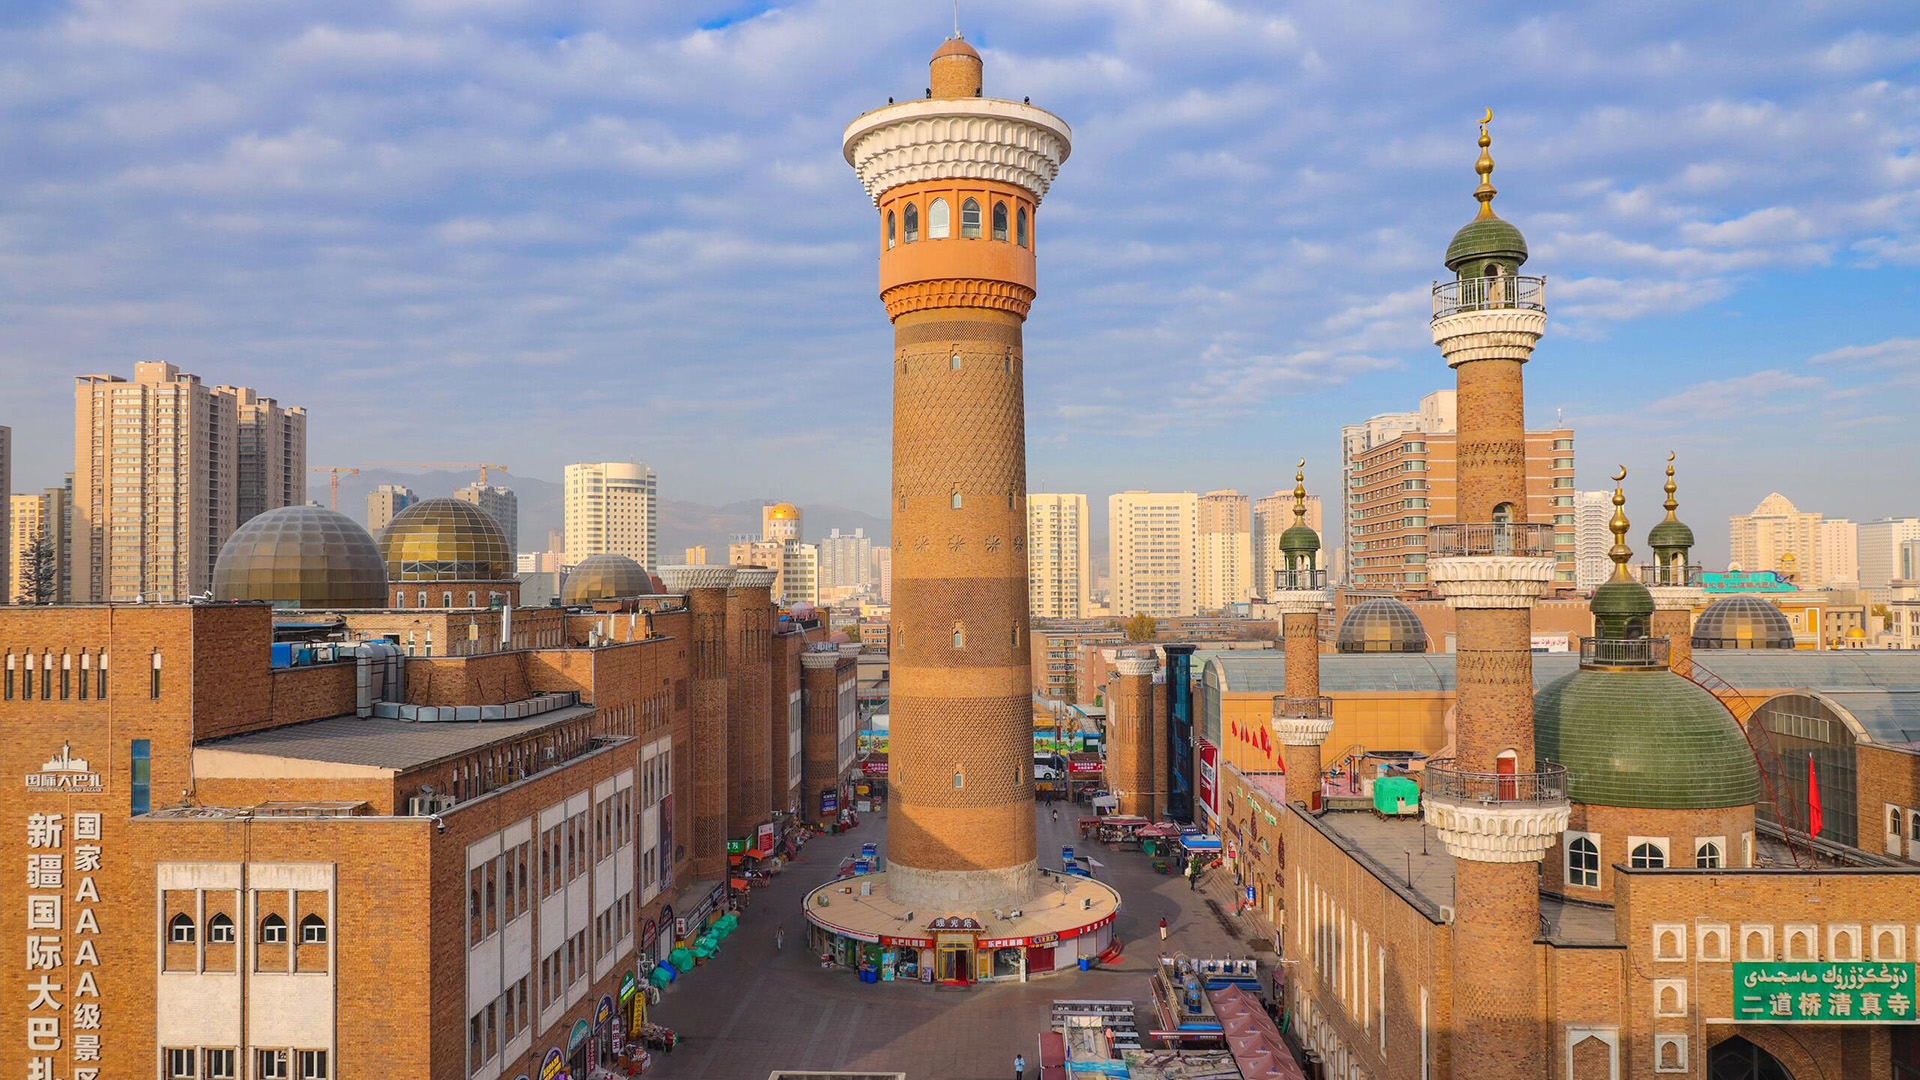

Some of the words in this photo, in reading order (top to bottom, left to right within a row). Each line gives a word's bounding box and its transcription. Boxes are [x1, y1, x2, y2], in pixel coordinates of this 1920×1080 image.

[25, 774, 104, 787] 国际大巴扎
[936, 919, 972, 928] 观光塔
[27, 813, 63, 1080] 新疆国际大巴扎
[1741, 992, 1911, 1016] 二道桥清真寺
